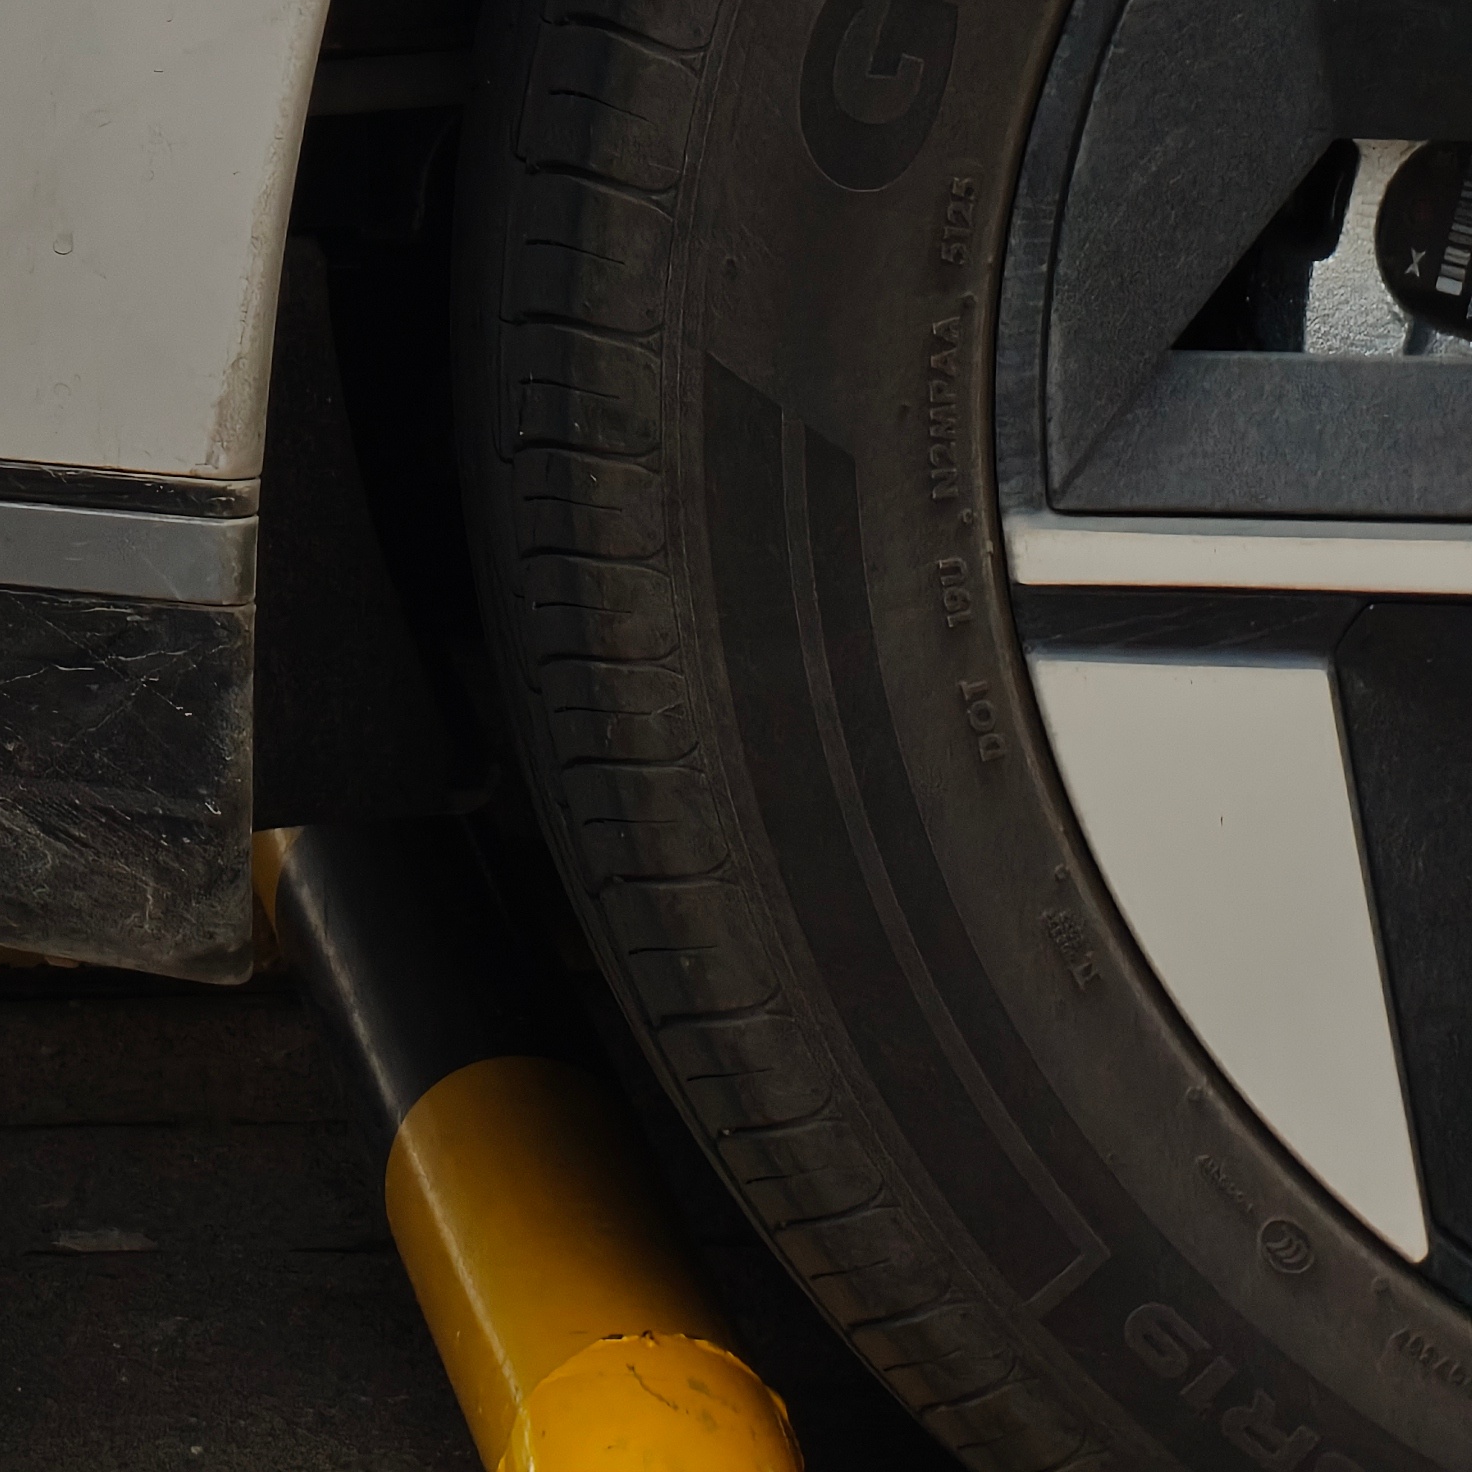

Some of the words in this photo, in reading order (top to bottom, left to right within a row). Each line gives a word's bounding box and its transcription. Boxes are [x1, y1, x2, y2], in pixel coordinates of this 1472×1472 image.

[940, 175, 976, 266] 5125
[937, 555, 973, 629] 19U
[958, 676, 1007, 762] DOT
